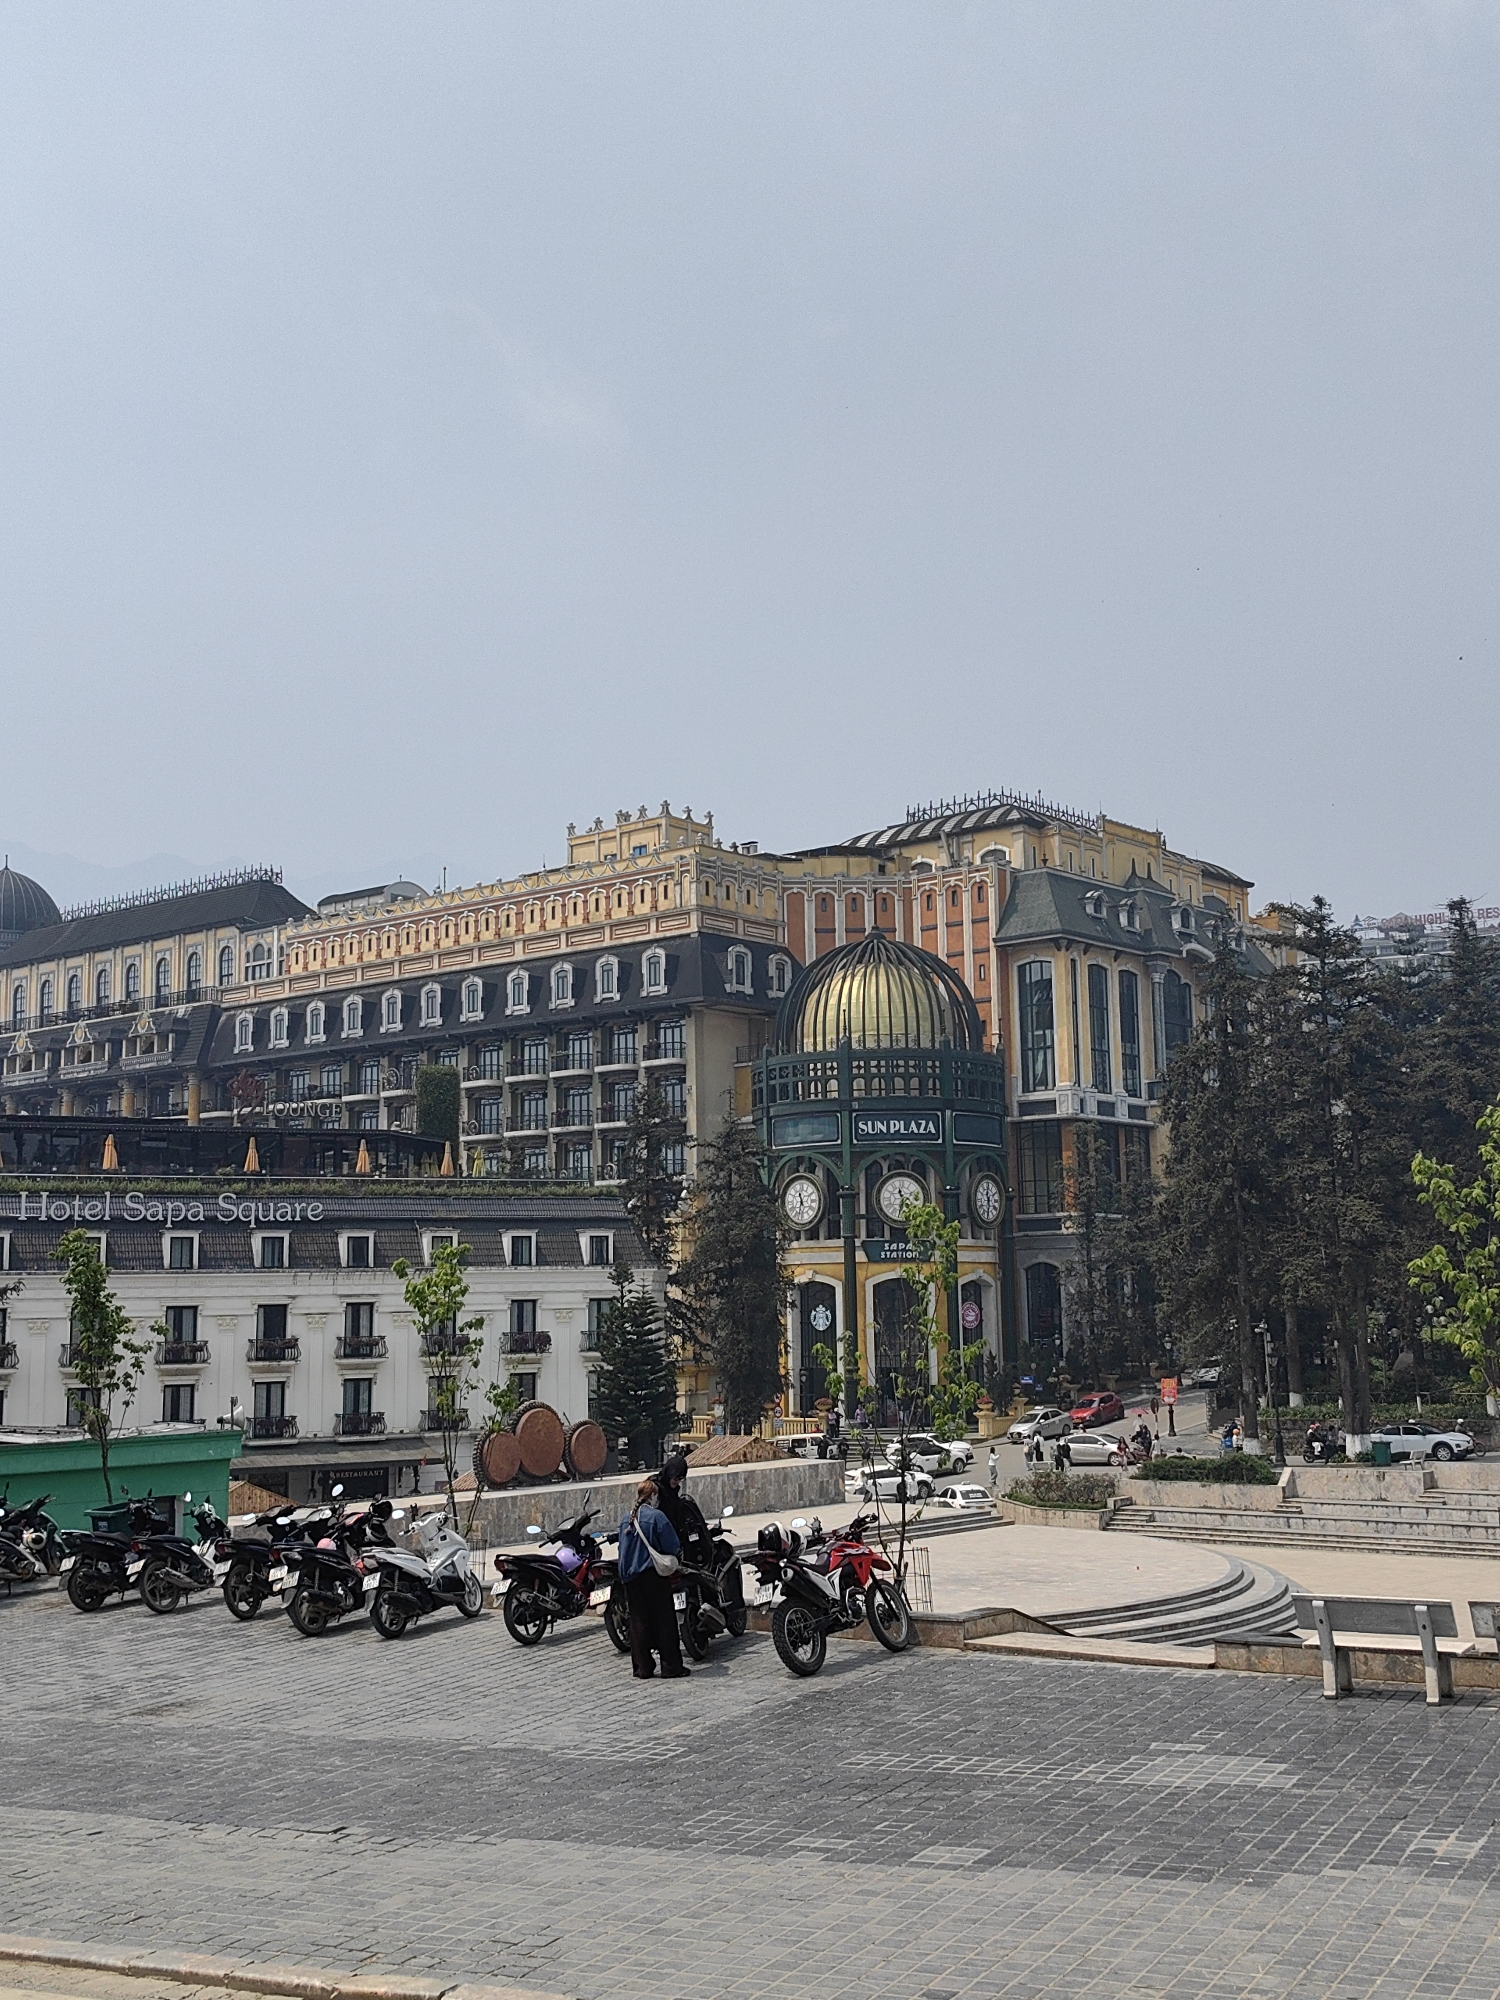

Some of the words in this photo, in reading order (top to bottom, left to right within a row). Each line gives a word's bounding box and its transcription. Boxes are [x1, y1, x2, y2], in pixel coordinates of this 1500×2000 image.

[262, 1101, 342, 1117] LOUNGE
[858, 1120, 887, 1135] SUN
[890, 1120, 936, 1134] PLAZA
[18, 1191, 111, 1221] Hotel
[123, 1191, 205, 1228] Sapa
[216, 1192, 324, 1228] Square
[880, 1251, 919, 1259] STATION
